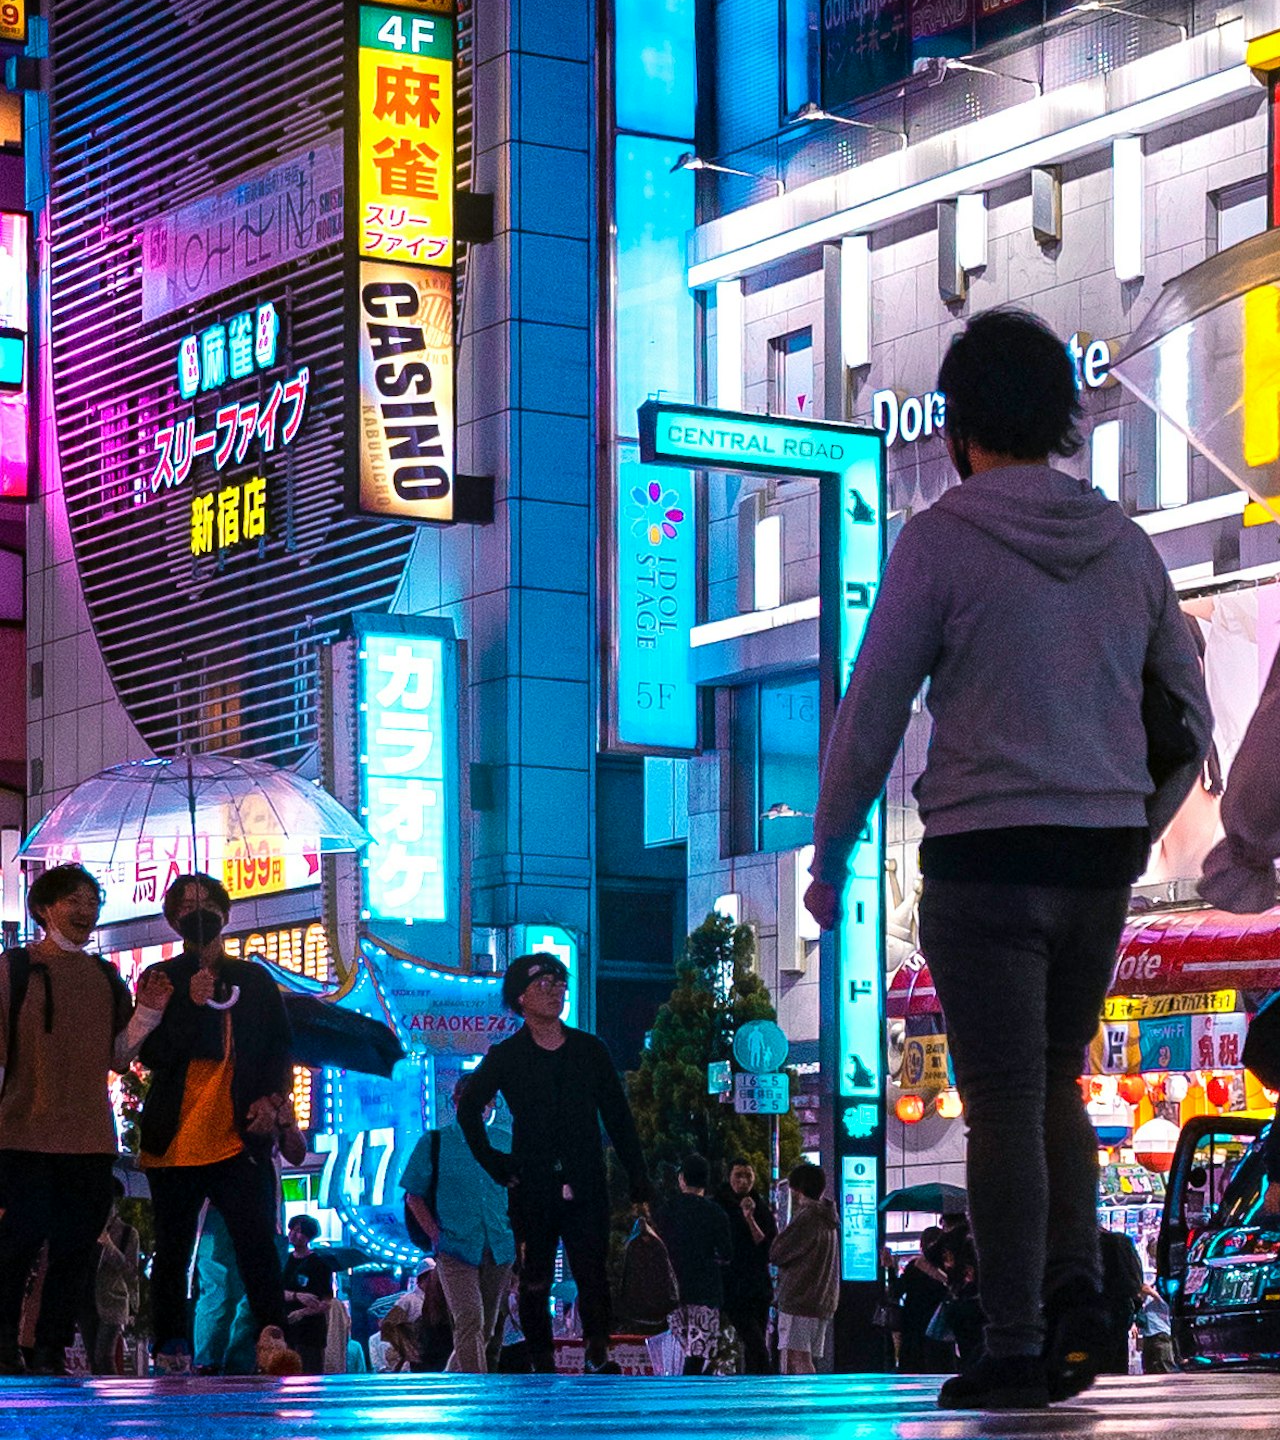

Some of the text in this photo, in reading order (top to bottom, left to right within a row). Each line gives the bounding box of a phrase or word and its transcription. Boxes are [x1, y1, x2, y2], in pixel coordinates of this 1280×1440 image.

[378, 15, 435, 53] 4F
[372, 65, 441, 201] 麻雀
[365, 231, 448, 258] ファイブ
[366, 205, 428, 228] スリー
[202, 310, 254, 392] 麻雀
[151, 366, 310, 493] スリーファイブ
[361, 282, 451, 502] CASINO
[668, 425, 845, 461] CENTRAL ROAD
[190, 476, 267, 556] 新宿店
[635, 553, 658, 649] STAGE
[658, 553, 678, 635] IDOL
[636, 681, 677, 710] 5F
[373, 643, 432, 906] カラオケ
[1198, 1033, 1240, 1067] 免税
[316, 1127, 395, 1207] 747
